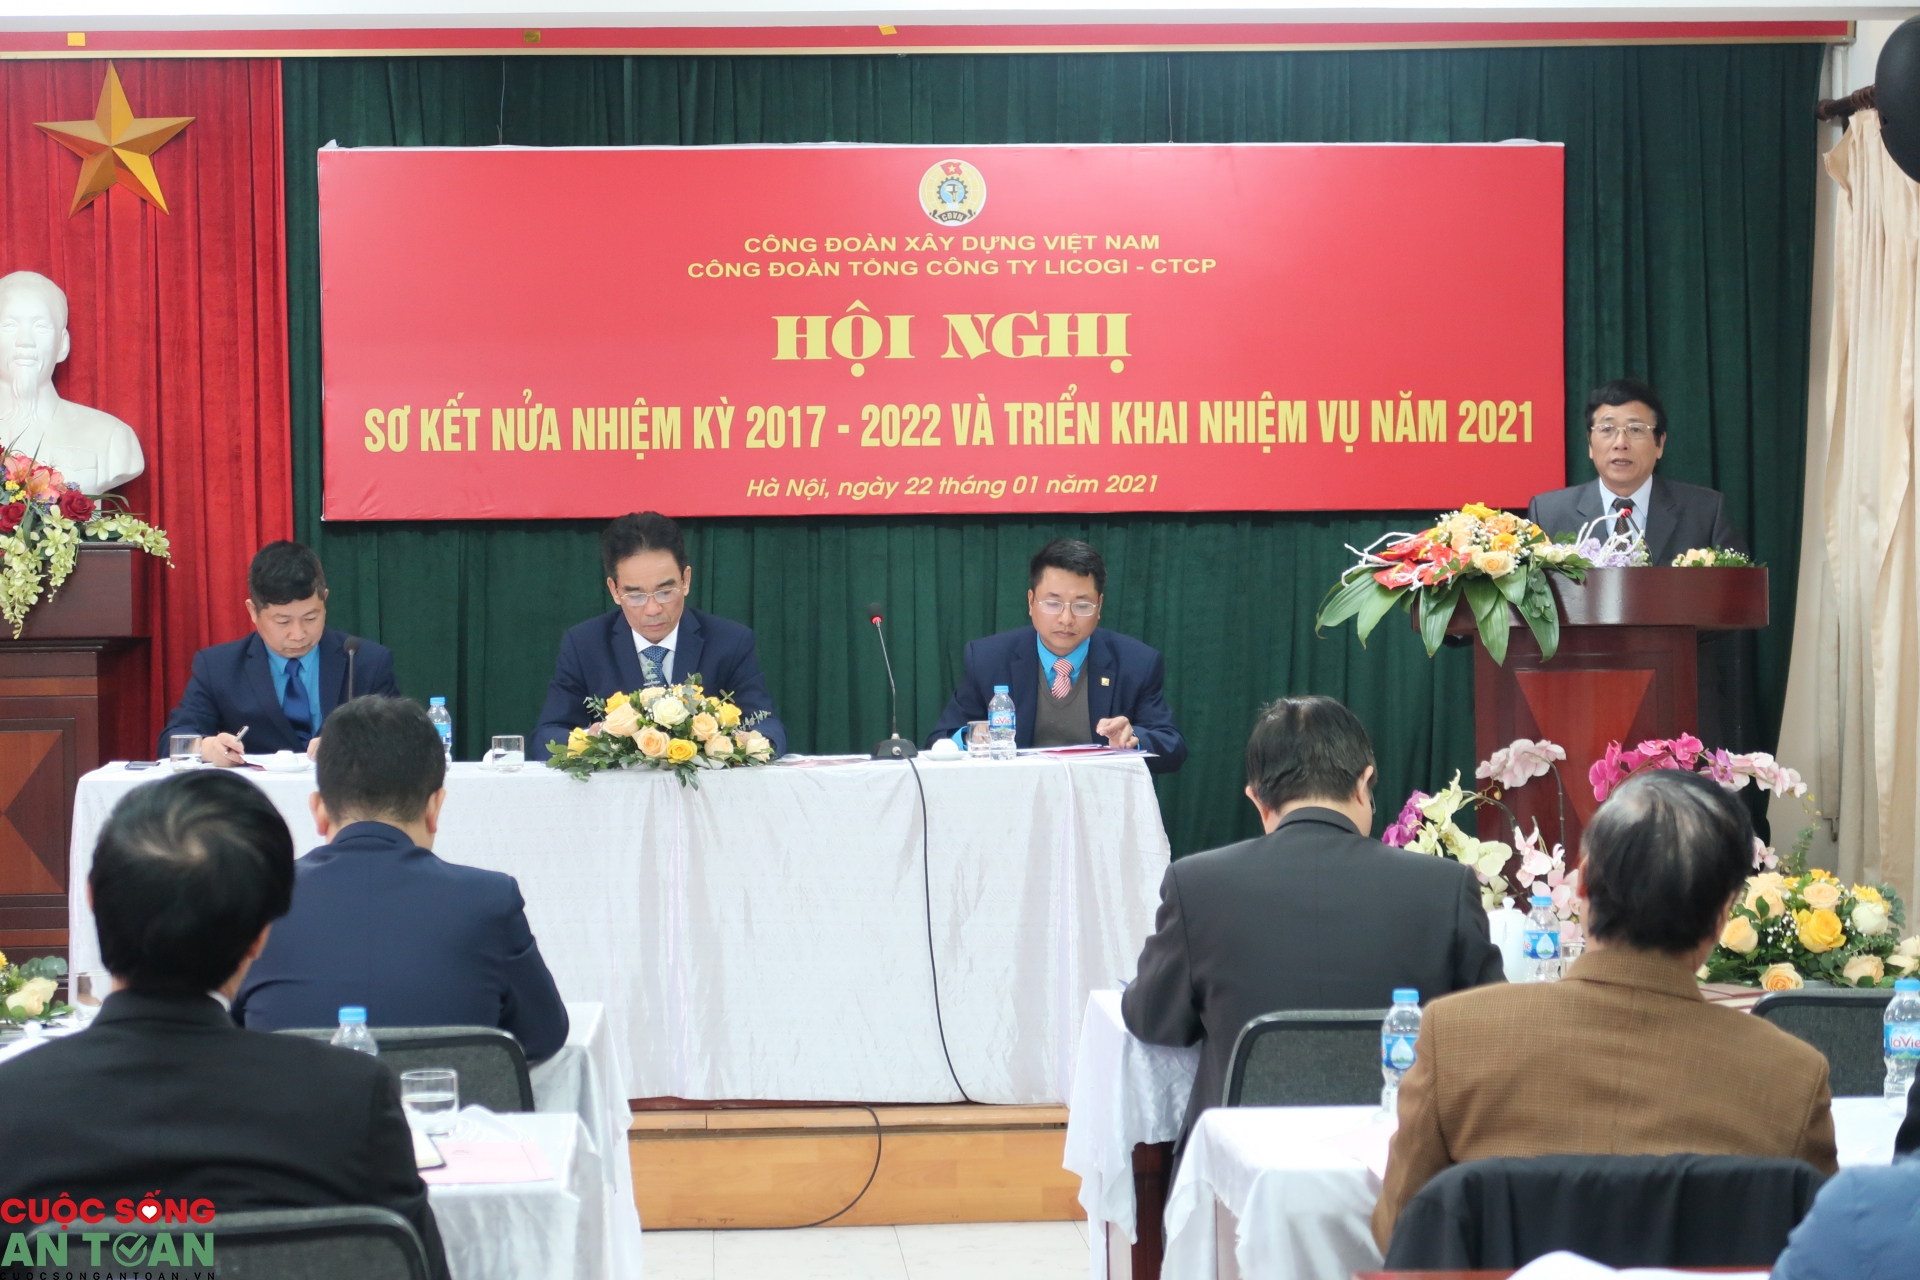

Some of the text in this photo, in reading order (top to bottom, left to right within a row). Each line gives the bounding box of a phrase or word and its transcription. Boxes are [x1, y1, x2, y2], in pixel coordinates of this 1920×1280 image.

[744, 233, 1160, 254] CÔNG ĐOÀN XÂY DỰNG VIỆT NAM
[687, 258, 761, 279] CÔNG
[767, 257, 840, 277] ĐOÀN
[848, 257, 919, 277] TỔNG
[925, 256, 1000, 276] CÔNG
[1006, 259, 1038, 275] TY
[1045, 259, 1129, 275] LICOGI
[1150, 258, 1217, 274] CTCP
[771, 299, 1132, 378] HỘI NGHỊ
[364, 383, 1532, 461] SƠ KẾT NỬA NHIỆM KỲ 2017 - 2022 VÀ TRIỂN KHAI NHIỆM VỤ NĂM 2021
[746, 474, 1158, 501] Hà Nội, ngày 22 tháng 01 năm 2021
